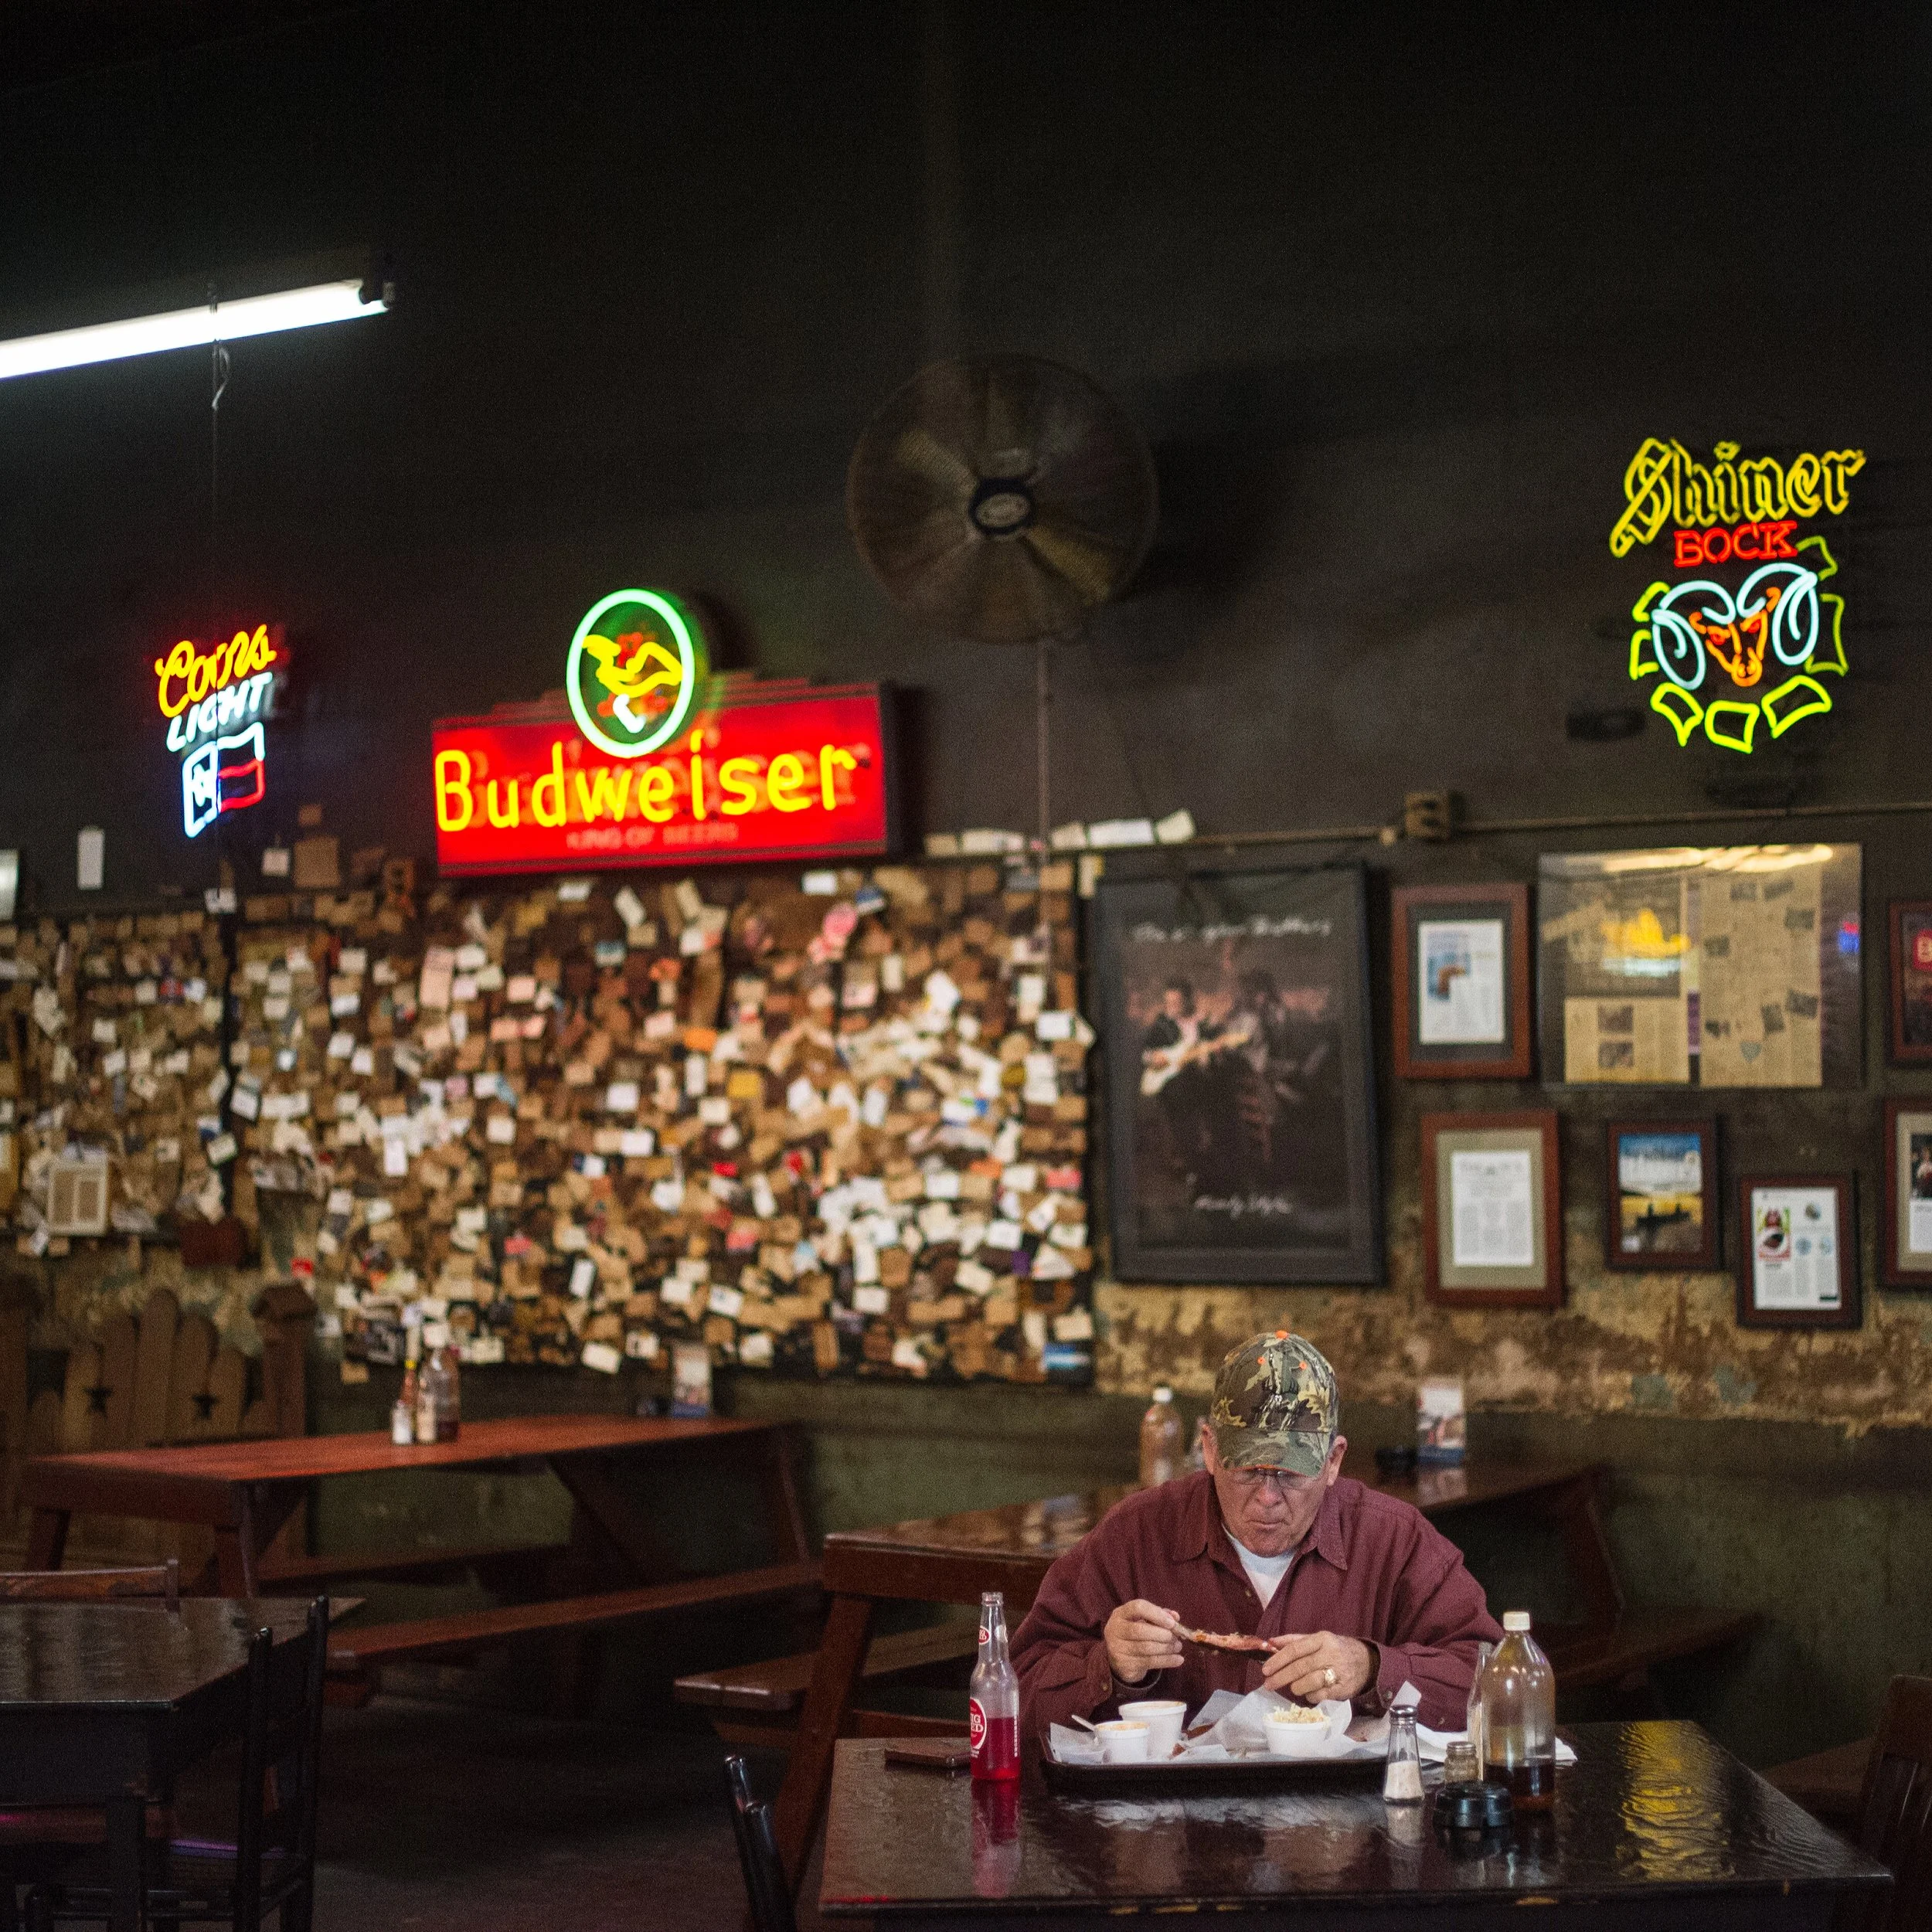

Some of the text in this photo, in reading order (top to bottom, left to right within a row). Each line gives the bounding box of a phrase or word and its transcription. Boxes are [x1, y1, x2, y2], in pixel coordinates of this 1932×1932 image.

[1610, 437, 1866, 557] Shiner
[1674, 520, 1798, 567] BOCK
[155, 624, 277, 718] Coors
[166, 671, 273, 752] LIGHT
[434, 730, 855, 832] Budweiser
[971, 1723, 984, 1733] ED
